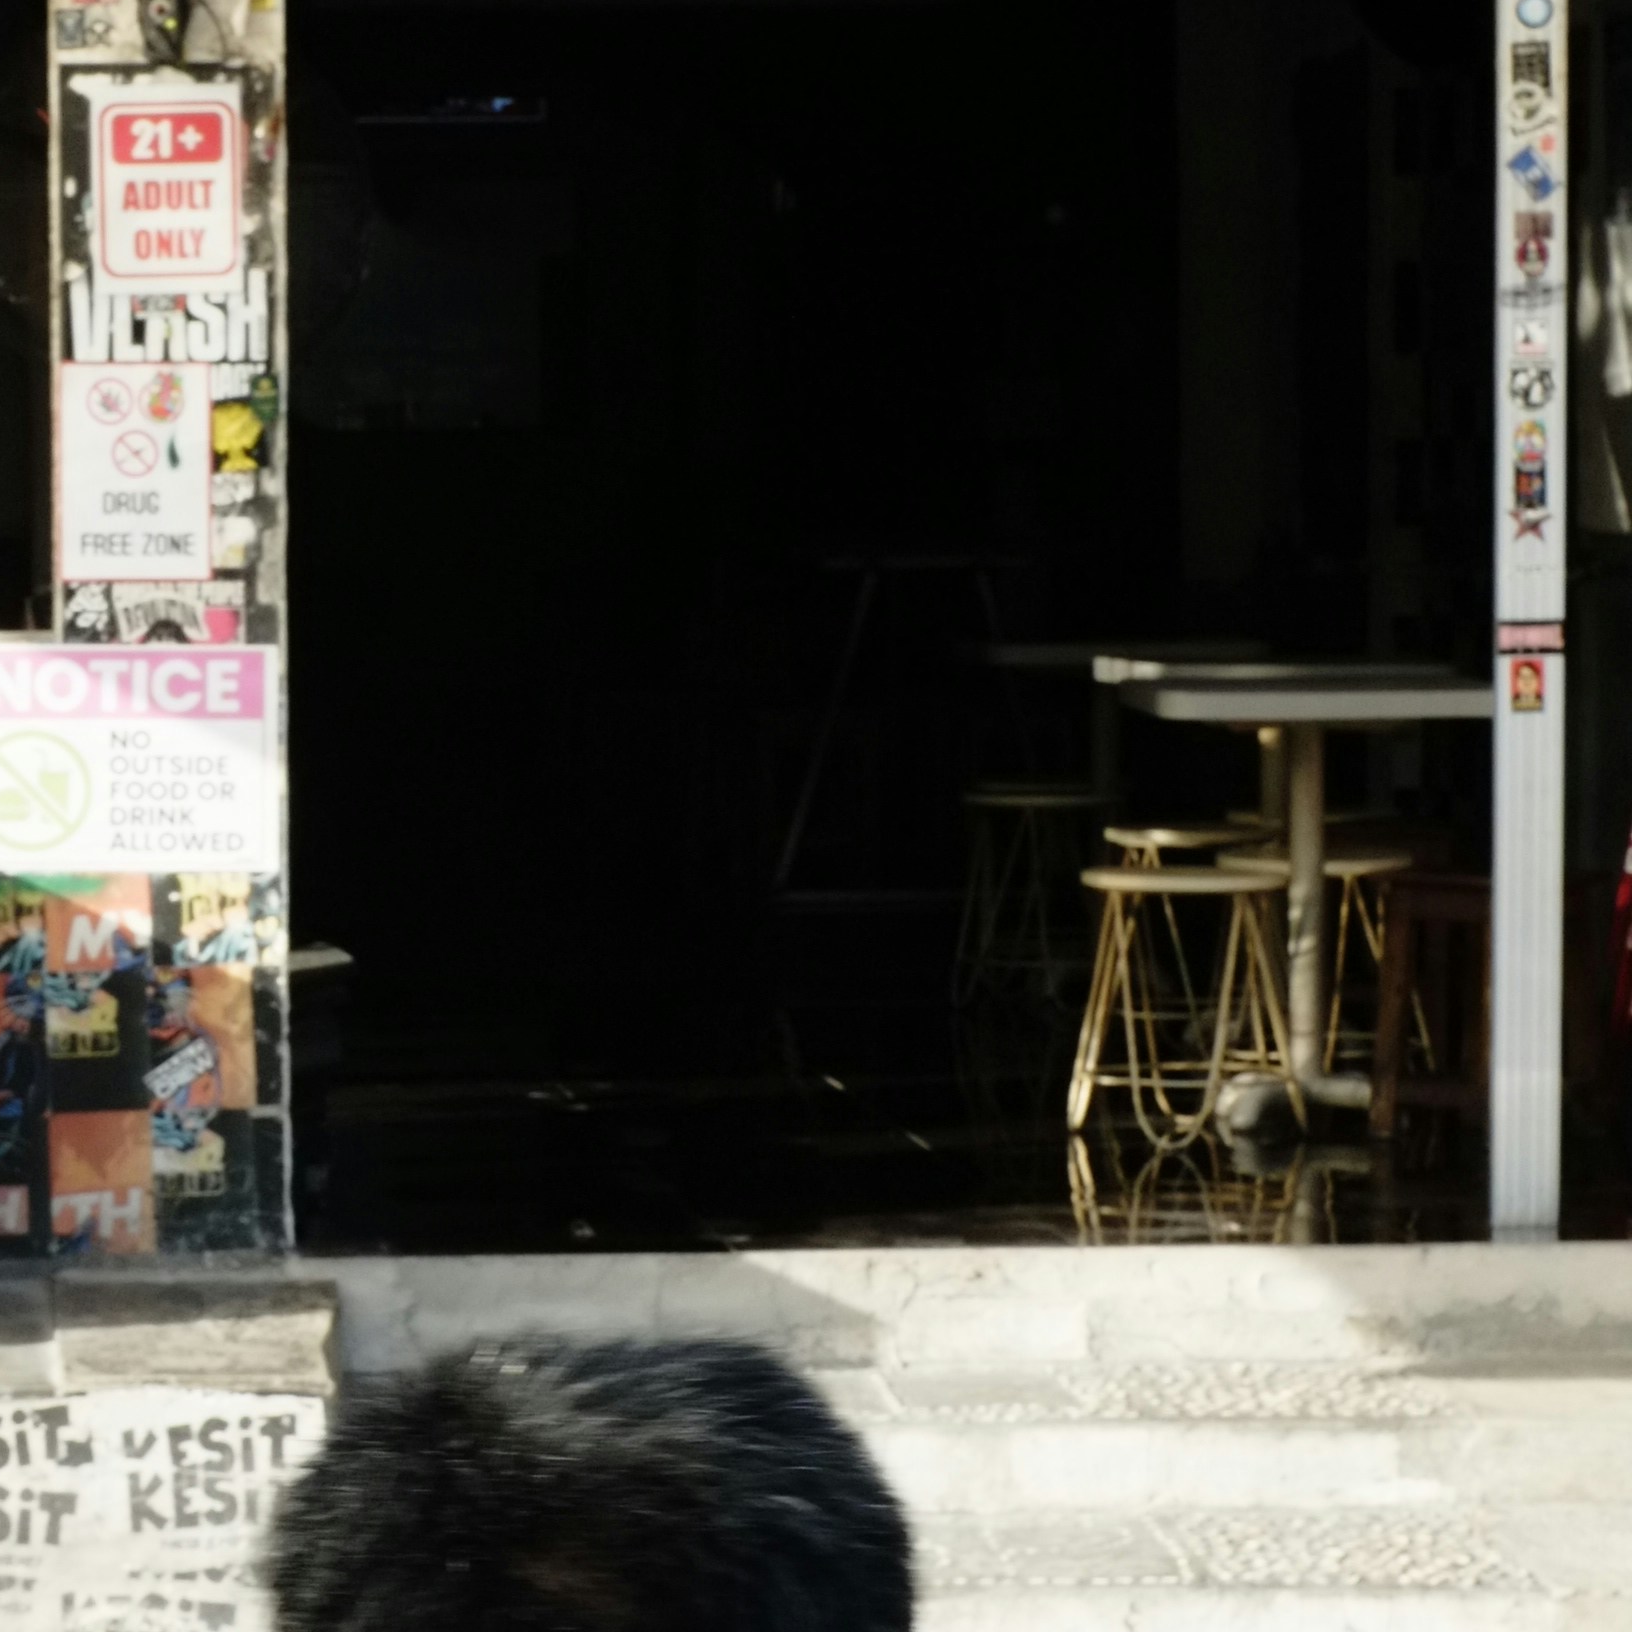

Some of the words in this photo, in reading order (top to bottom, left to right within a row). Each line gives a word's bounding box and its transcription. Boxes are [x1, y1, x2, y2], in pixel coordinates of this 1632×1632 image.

[129, 118, 203, 161] 21+
[123, 179, 214, 211] ADULT
[134, 228, 206, 261] ONLY
[102, 491, 160, 516] DRUG
[80, 533, 134, 556] FREE
[142, 533, 197, 556] ZONE
[109, 730, 152, 750] NO
[109, 755, 229, 776] OUTSIDE
[109, 781, 190, 802] FOOD
[197, 781, 236, 802] OR
[109, 806, 194, 827] DRINK
[109, 831, 245, 853] ALLOWED
